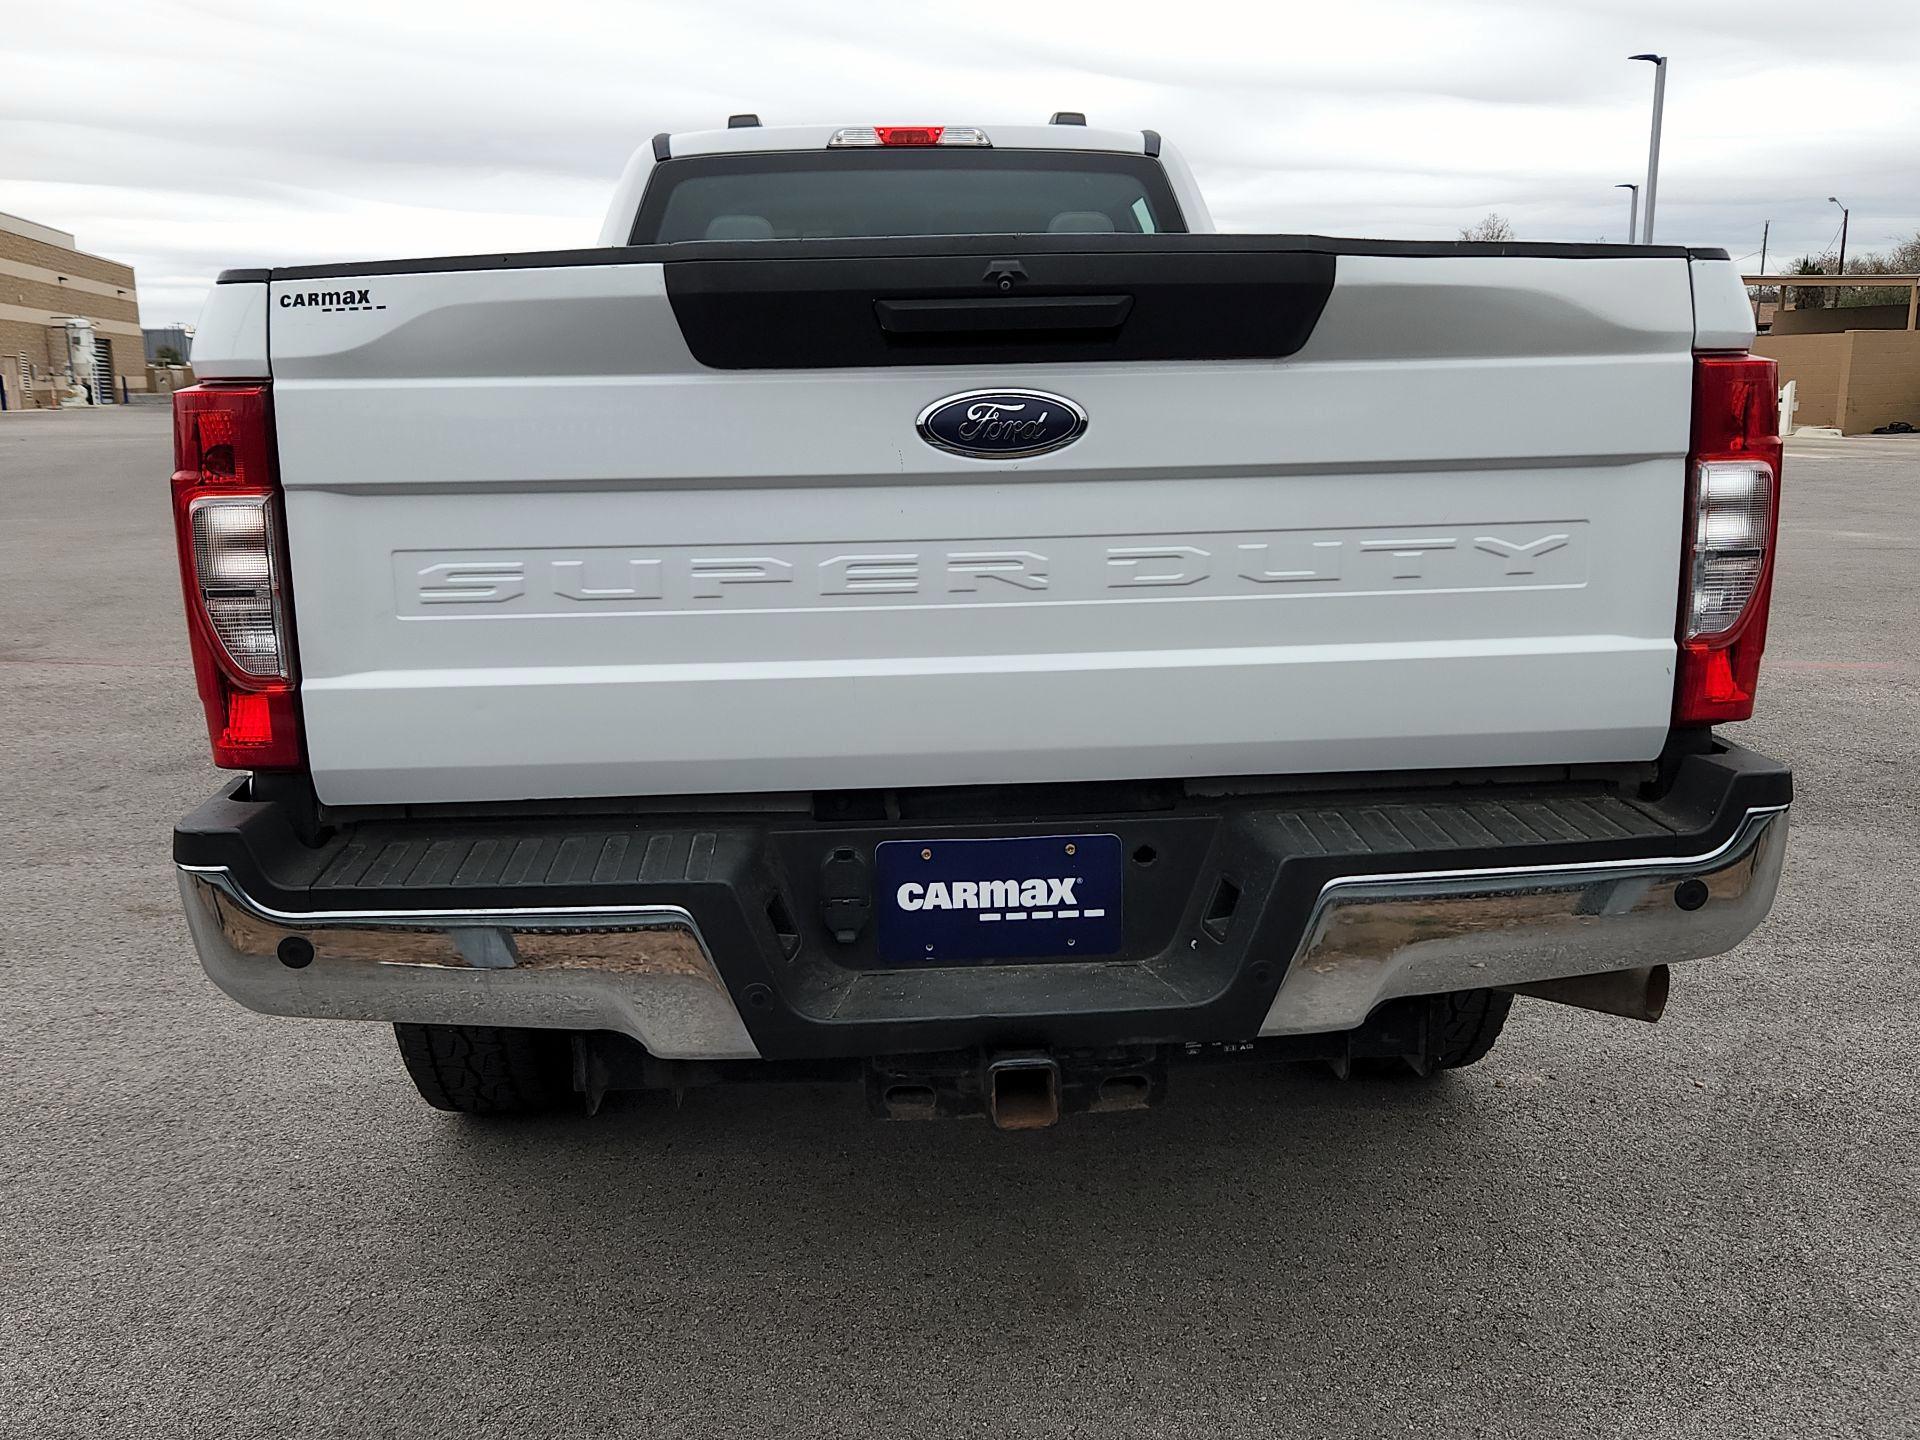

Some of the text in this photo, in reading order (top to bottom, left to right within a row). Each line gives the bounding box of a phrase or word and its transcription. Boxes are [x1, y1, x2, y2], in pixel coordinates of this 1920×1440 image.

[959, 402, 1048, 442] Ford
[417, 533, 1570, 604] SUPER DUTY
